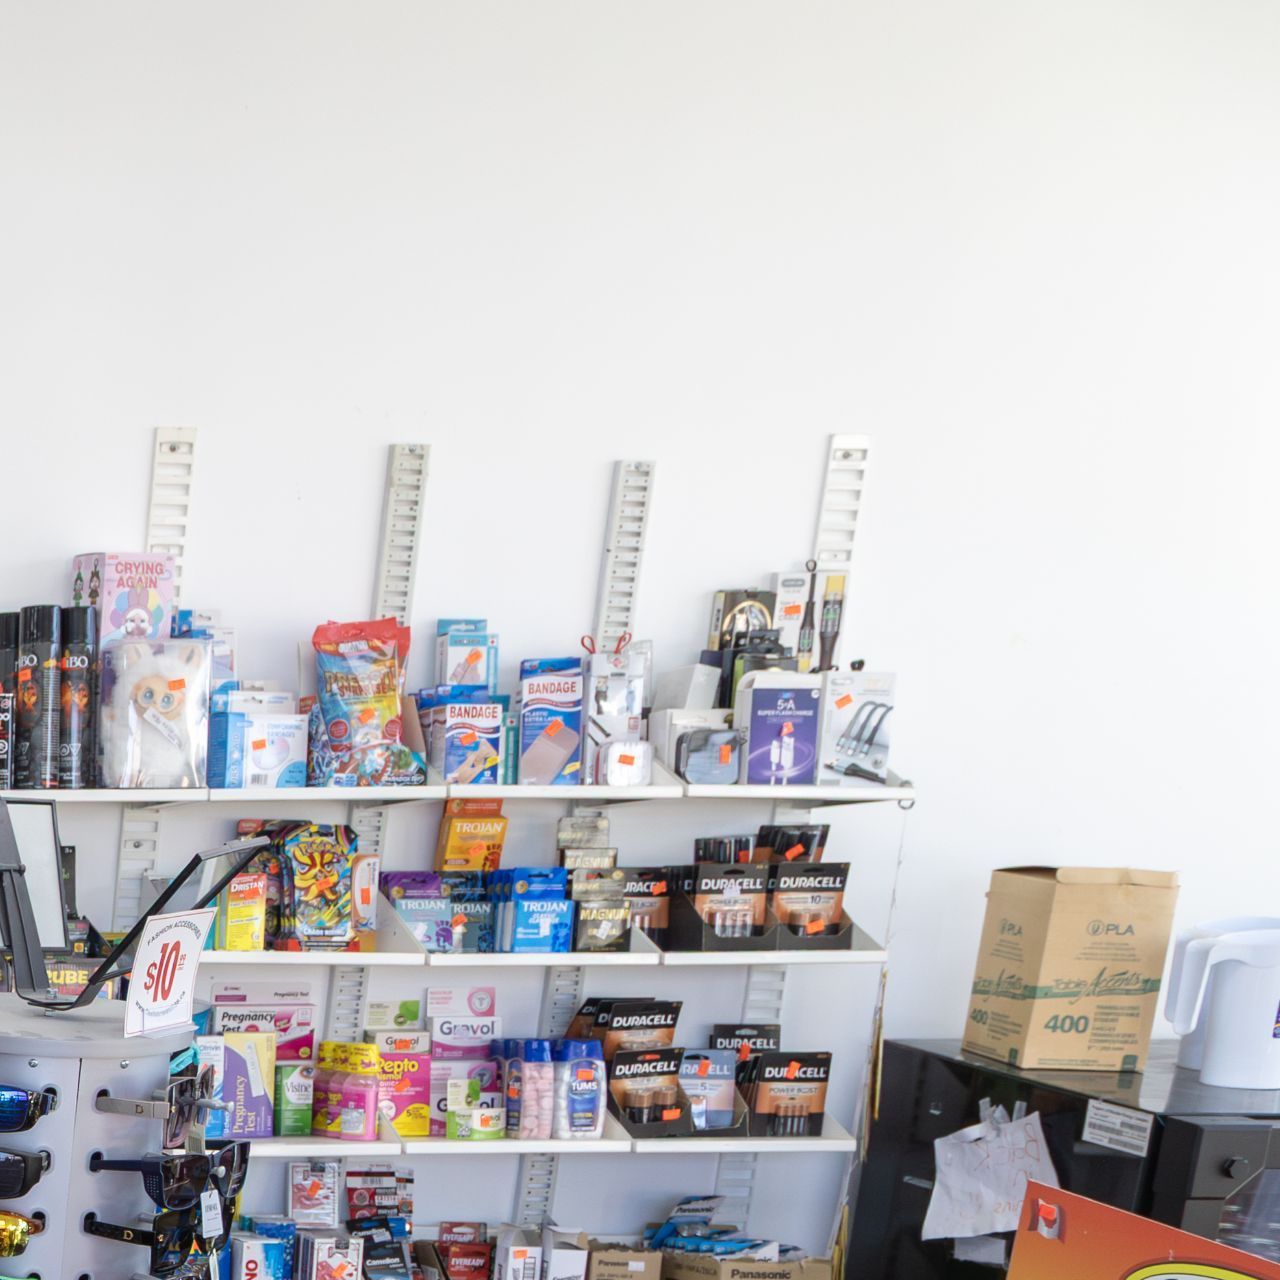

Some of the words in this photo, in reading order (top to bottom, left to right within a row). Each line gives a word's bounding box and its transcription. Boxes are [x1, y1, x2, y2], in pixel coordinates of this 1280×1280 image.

[116, 562, 164, 575] CRYING
[116, 576, 158, 588] AGAIN
[528, 682, 576, 694] BANDAGE
[450, 706, 498, 718] BANDAGE
[455, 822, 503, 832] TROJAN
[780, 877, 843, 888] DURACELL
[523, 902, 567, 912] TROJAN
[580, 908, 629, 920] MAGNUM
[221, 1012, 274, 1023] Pregnancy
[613, 1014, 674, 1027] DURACELL
[1044, 1016, 1089, 1033] 400
[285, 1082, 312, 1092] Visine
[572, 1081, 597, 1091] TUMS
[451, 1257, 484, 1268] EVEREADY
[731, 1269, 791, 1279] Panasonic
